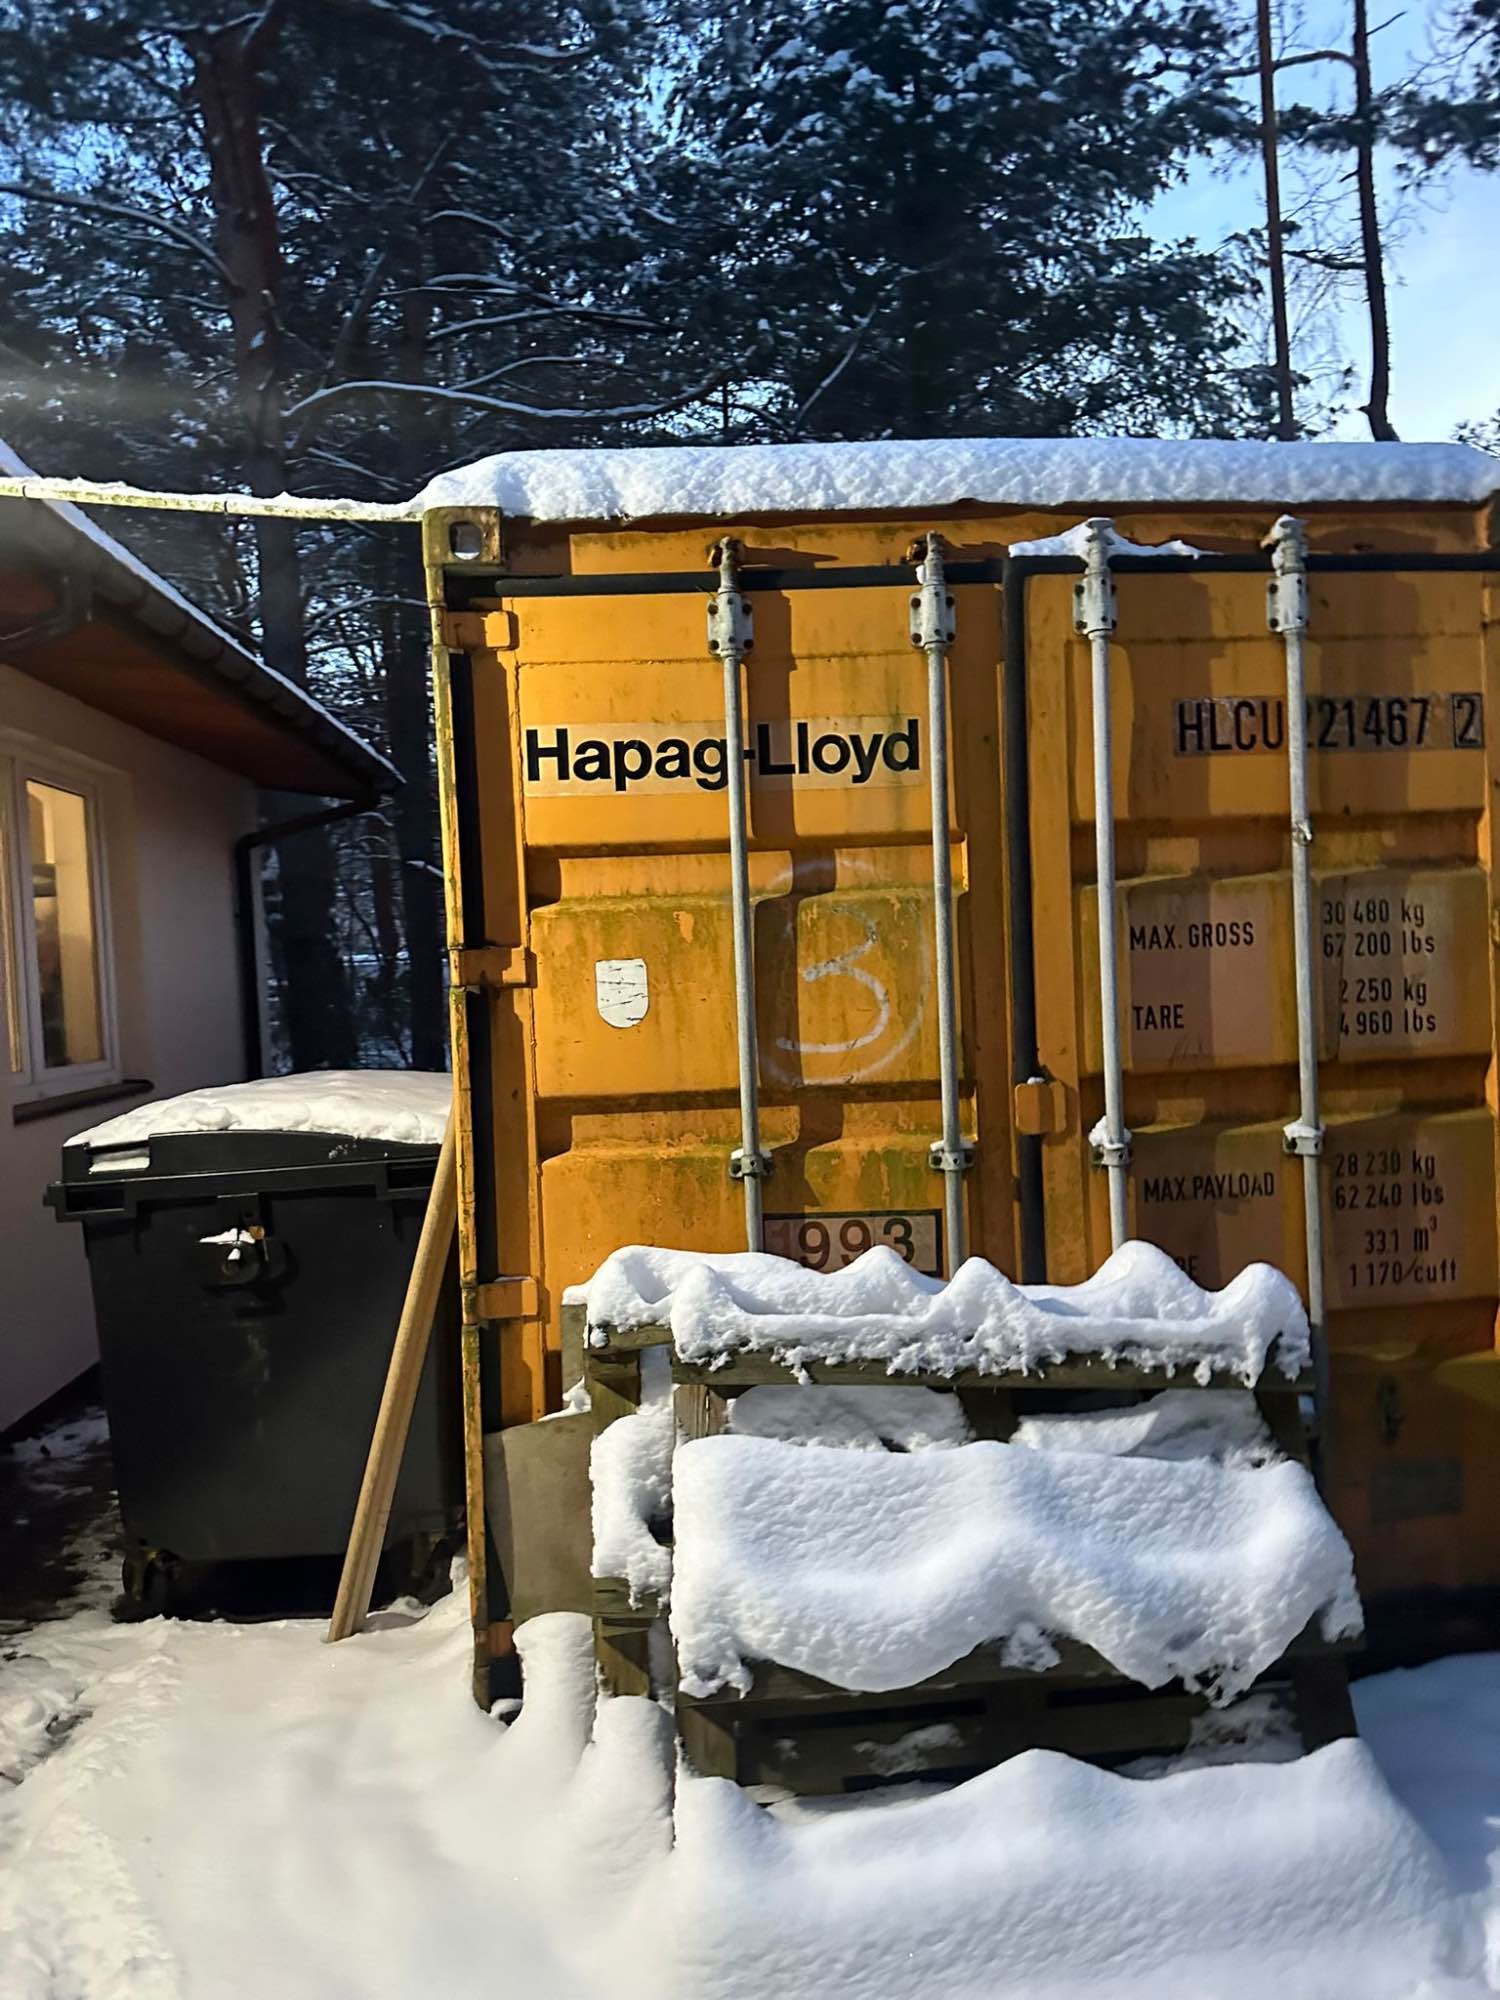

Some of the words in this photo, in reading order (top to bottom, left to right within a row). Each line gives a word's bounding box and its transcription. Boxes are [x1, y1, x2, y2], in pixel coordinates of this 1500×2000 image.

[1178, 701, 1284, 751] HLCU
[1304, 697, 1431, 749] 21467
[1454, 697, 1479, 744] 2
[525, 718, 921, 793] Hapag-Lloyd
[1353, 899, 1391, 925] 480
[1400, 898, 1425, 928] kg
[1129, 924, 1183, 951] MAX.
[1188, 921, 1255, 949] GROSS
[1354, 931, 1392, 957] 200
[1402, 930, 1436, 956] lbs
[1403, 976, 1428, 1007] kg
[1132, 1003, 1185, 1031] TARE
[1403, 1008, 1437, 1035] lbs
[1411, 1150, 1436, 1181] kg
[1192, 1170, 1275, 1201] PAYLOAD
[1411, 1182, 1445, 1207] lbs
